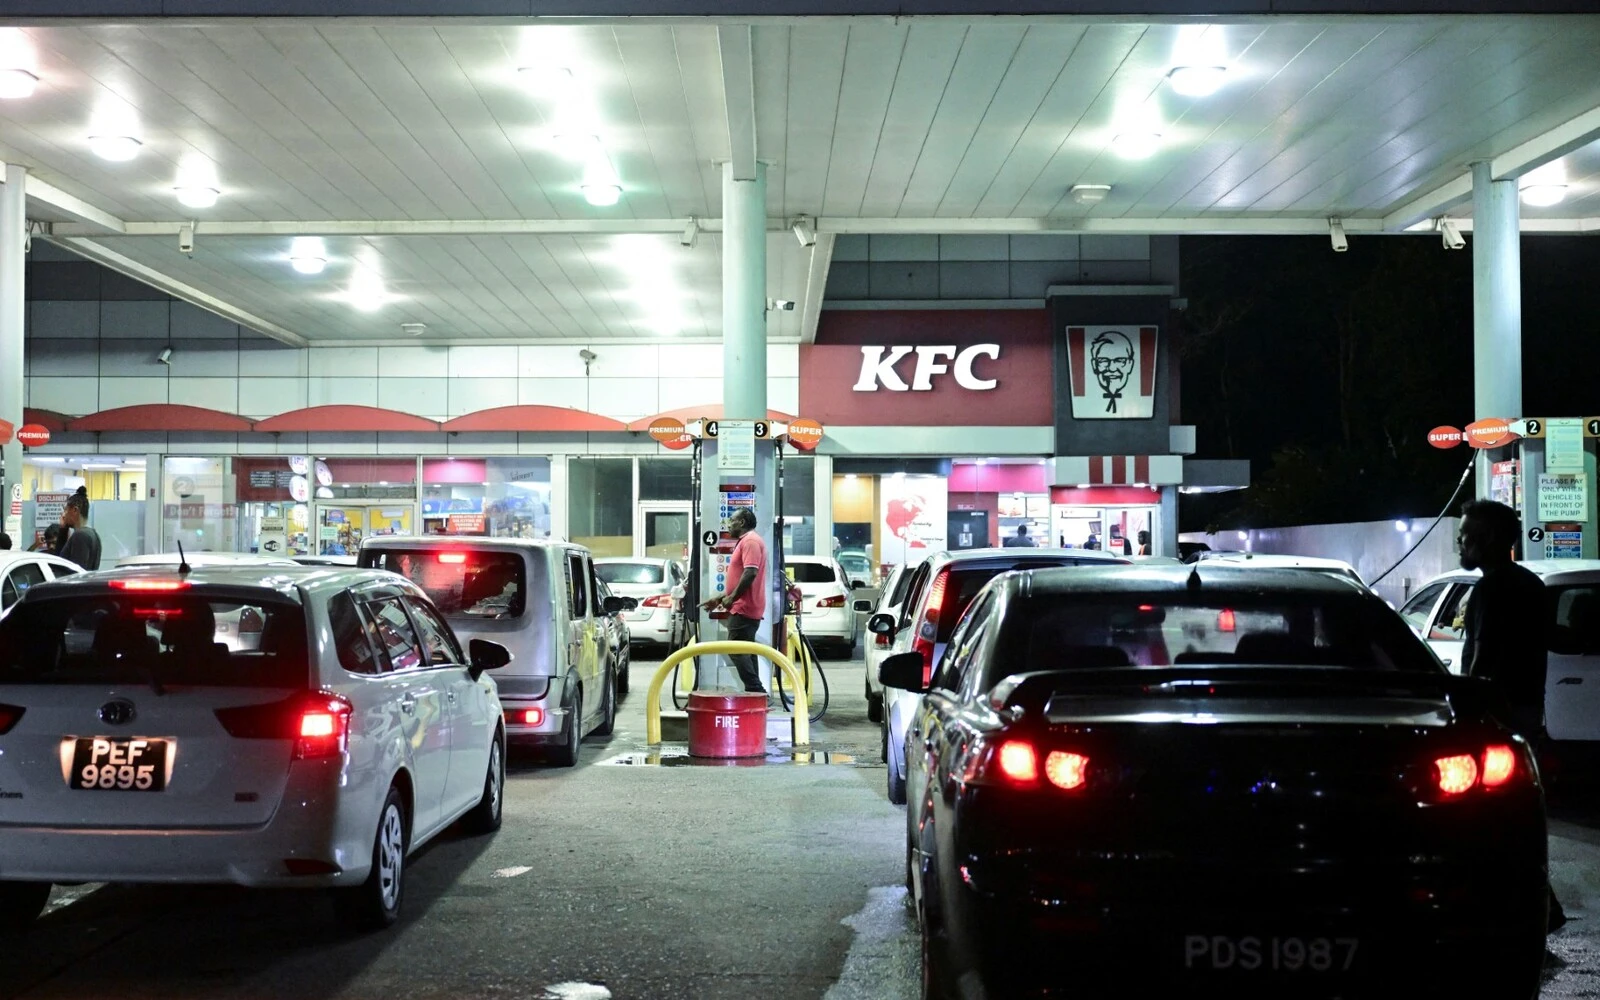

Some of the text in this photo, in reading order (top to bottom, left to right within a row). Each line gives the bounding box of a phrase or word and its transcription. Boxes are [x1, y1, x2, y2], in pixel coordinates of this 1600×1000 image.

[852, 343, 1000, 392] KFC
[709, 422, 717, 435] 4
[756, 423, 764, 436] 3
[790, 426, 822, 436] SUPER
[1471, 426, 1508, 435] PREMIUM
[1529, 421, 1538, 434] 2
[1591, 421, 1599, 434] 1
[18, 431, 50, 440] PREMIUM
[1430, 433, 1461, 442] SUPER
[706, 531, 714, 545] 4
[1531, 528, 1540, 541] 2
[714, 715, 740, 728] FIRE
[91, 740, 148, 765] PEF
[80, 764, 155, 789] 9895
[1185, 935, 1360, 971] PDS 1987
